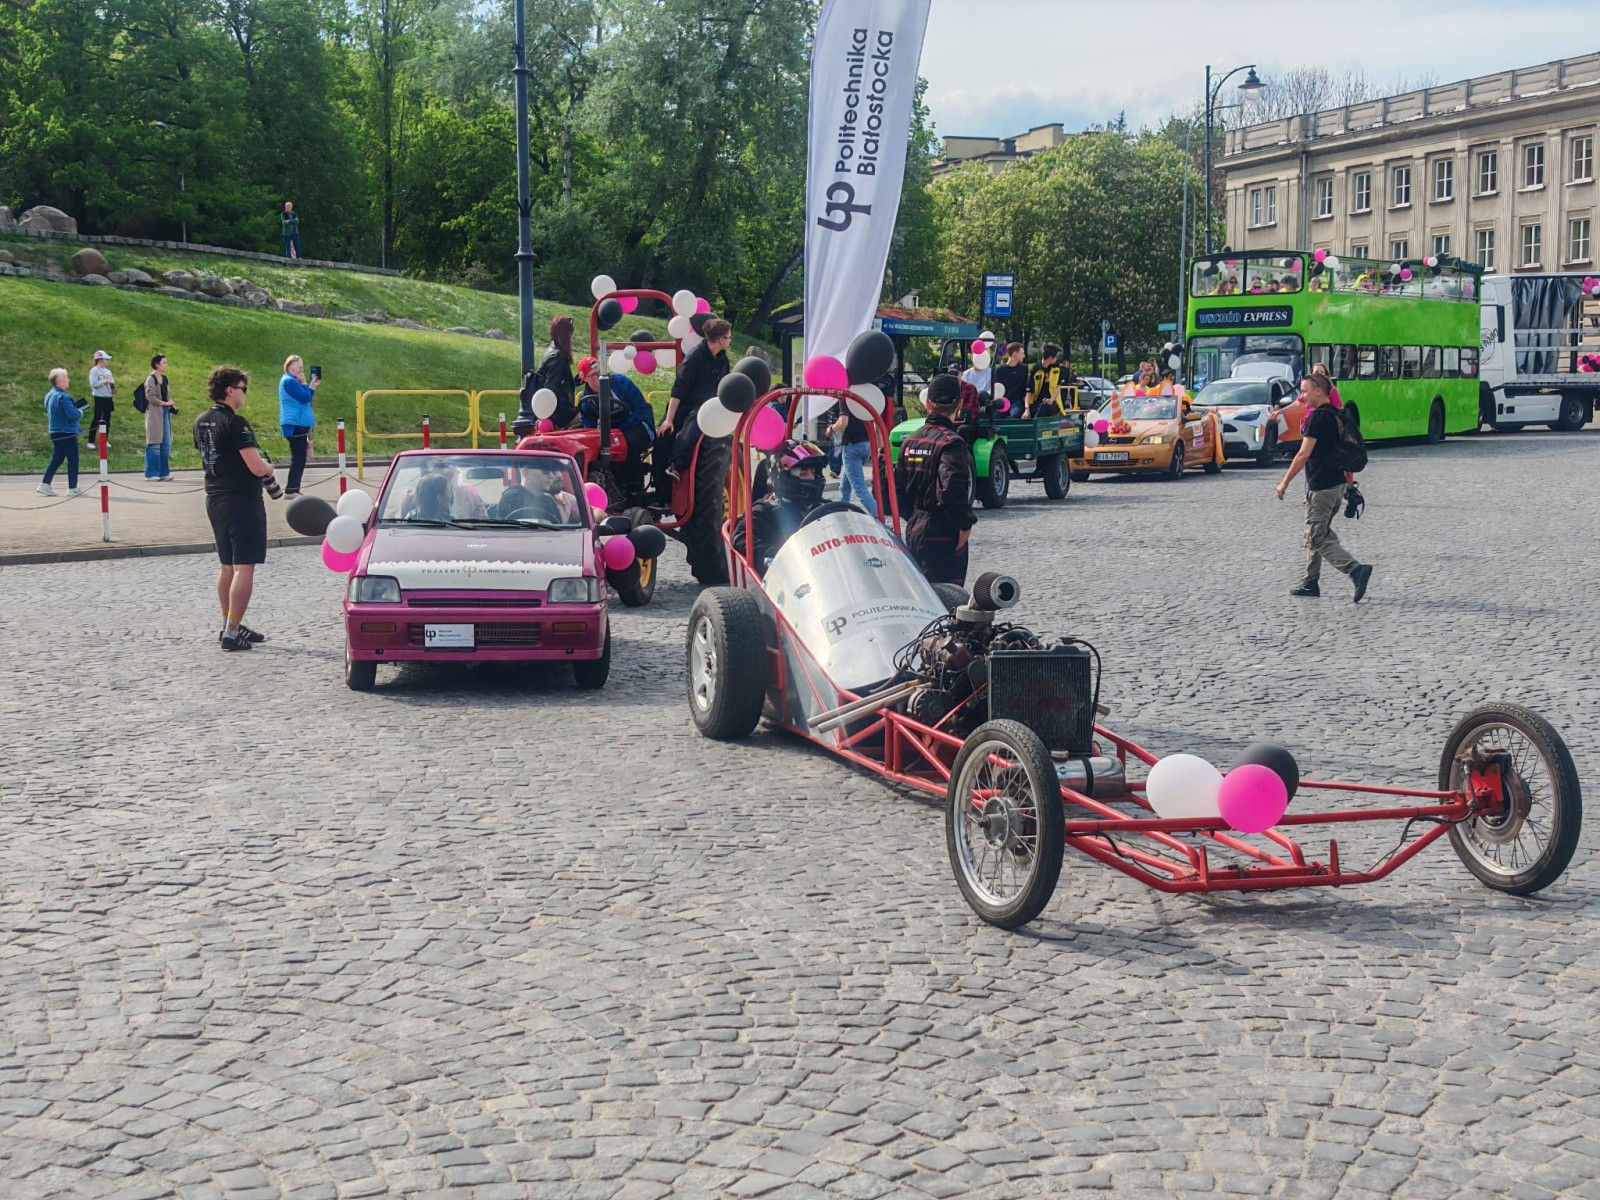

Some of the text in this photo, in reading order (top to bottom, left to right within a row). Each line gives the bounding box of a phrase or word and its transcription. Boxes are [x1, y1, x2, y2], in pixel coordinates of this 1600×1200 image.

[835, 28, 868, 173] Politechnika
[857, 30, 894, 176] Białostocka
[1243, 311, 1288, 322] EXPRESS
[1107, 335, 1115, 347] P
[851, 604, 918, 619] POLITECHNIKA
